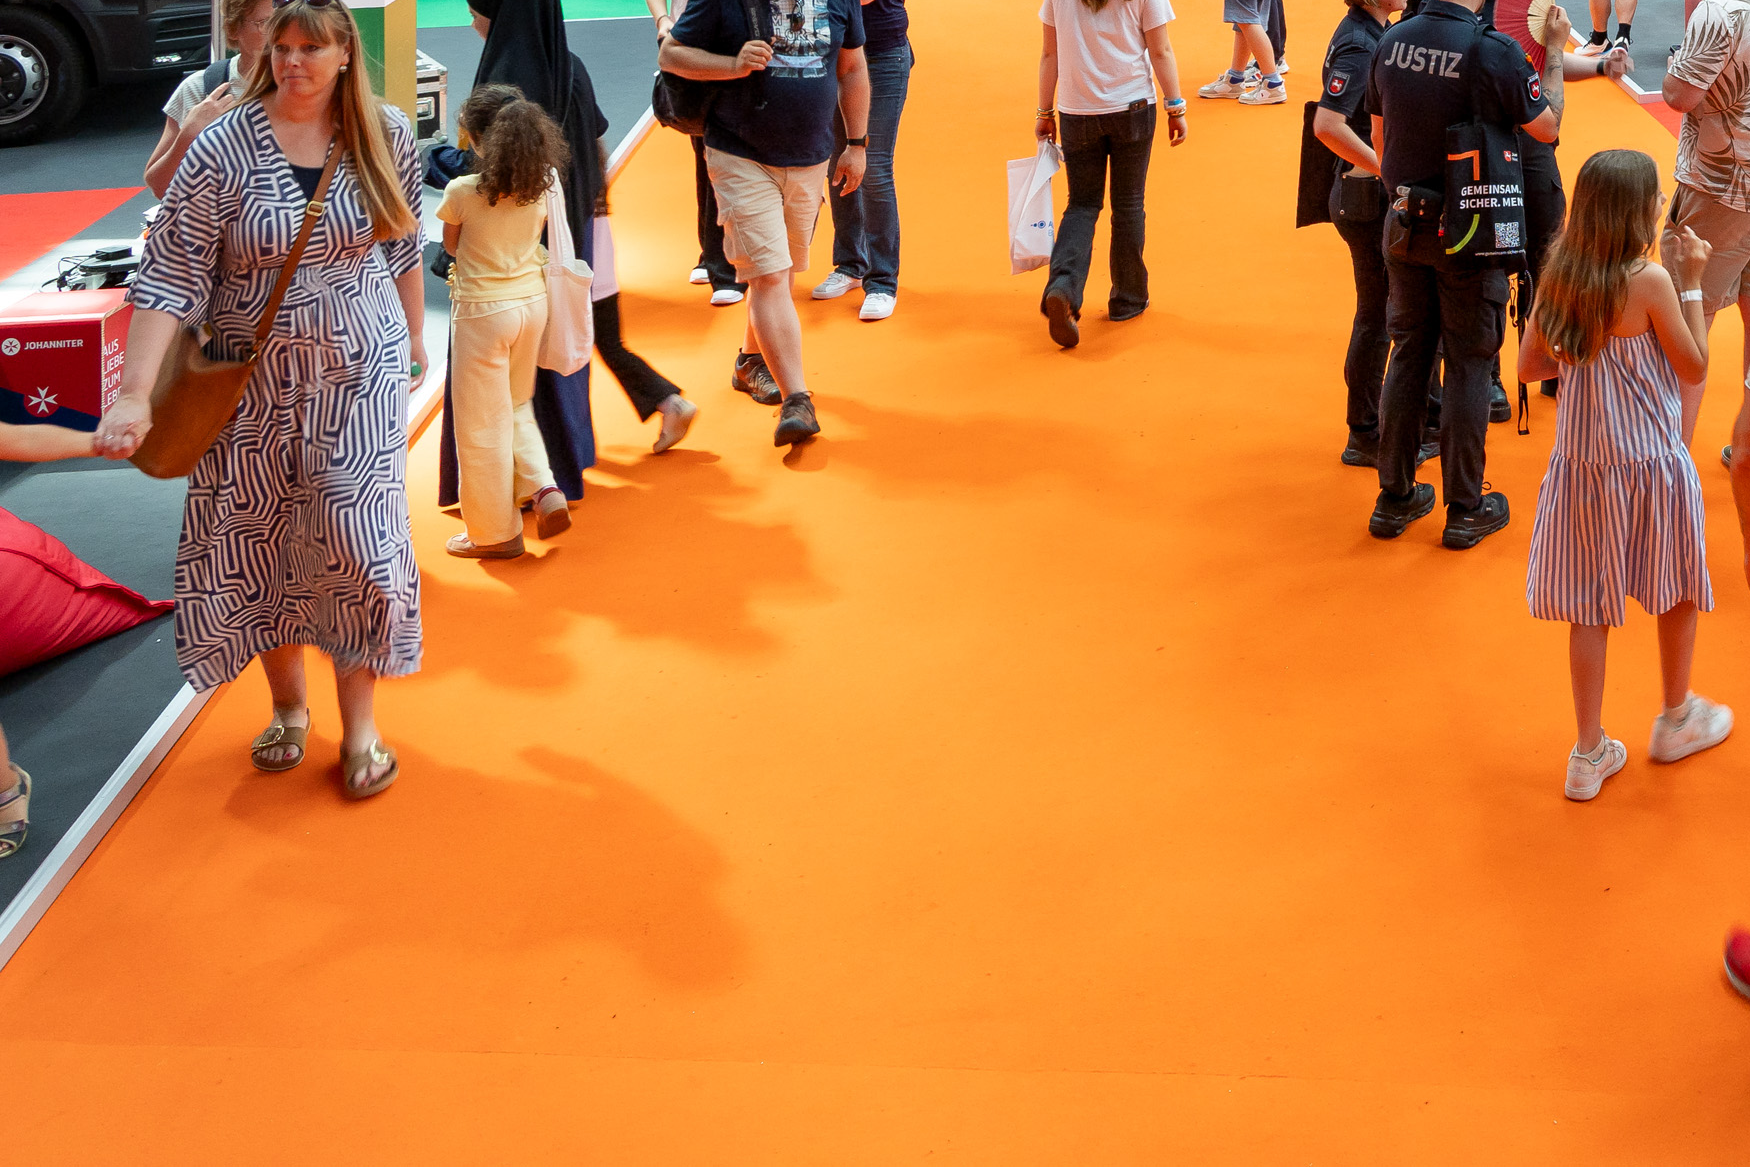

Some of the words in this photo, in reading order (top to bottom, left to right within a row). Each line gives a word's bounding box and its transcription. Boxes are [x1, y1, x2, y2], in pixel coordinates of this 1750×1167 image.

[1385, 41, 1463, 79] JUSTIZ
[1461, 185, 1521, 196] GEMEINSAM.
[1460, 198, 1500, 209] SICHER.
[1503, 197, 1523, 207] MEN
[24, 339, 83, 350] JOHANNITER
[103, 339, 119, 356] AUS
[103, 351, 124, 374] LIEBE
[103, 370, 120, 391] ZUM
